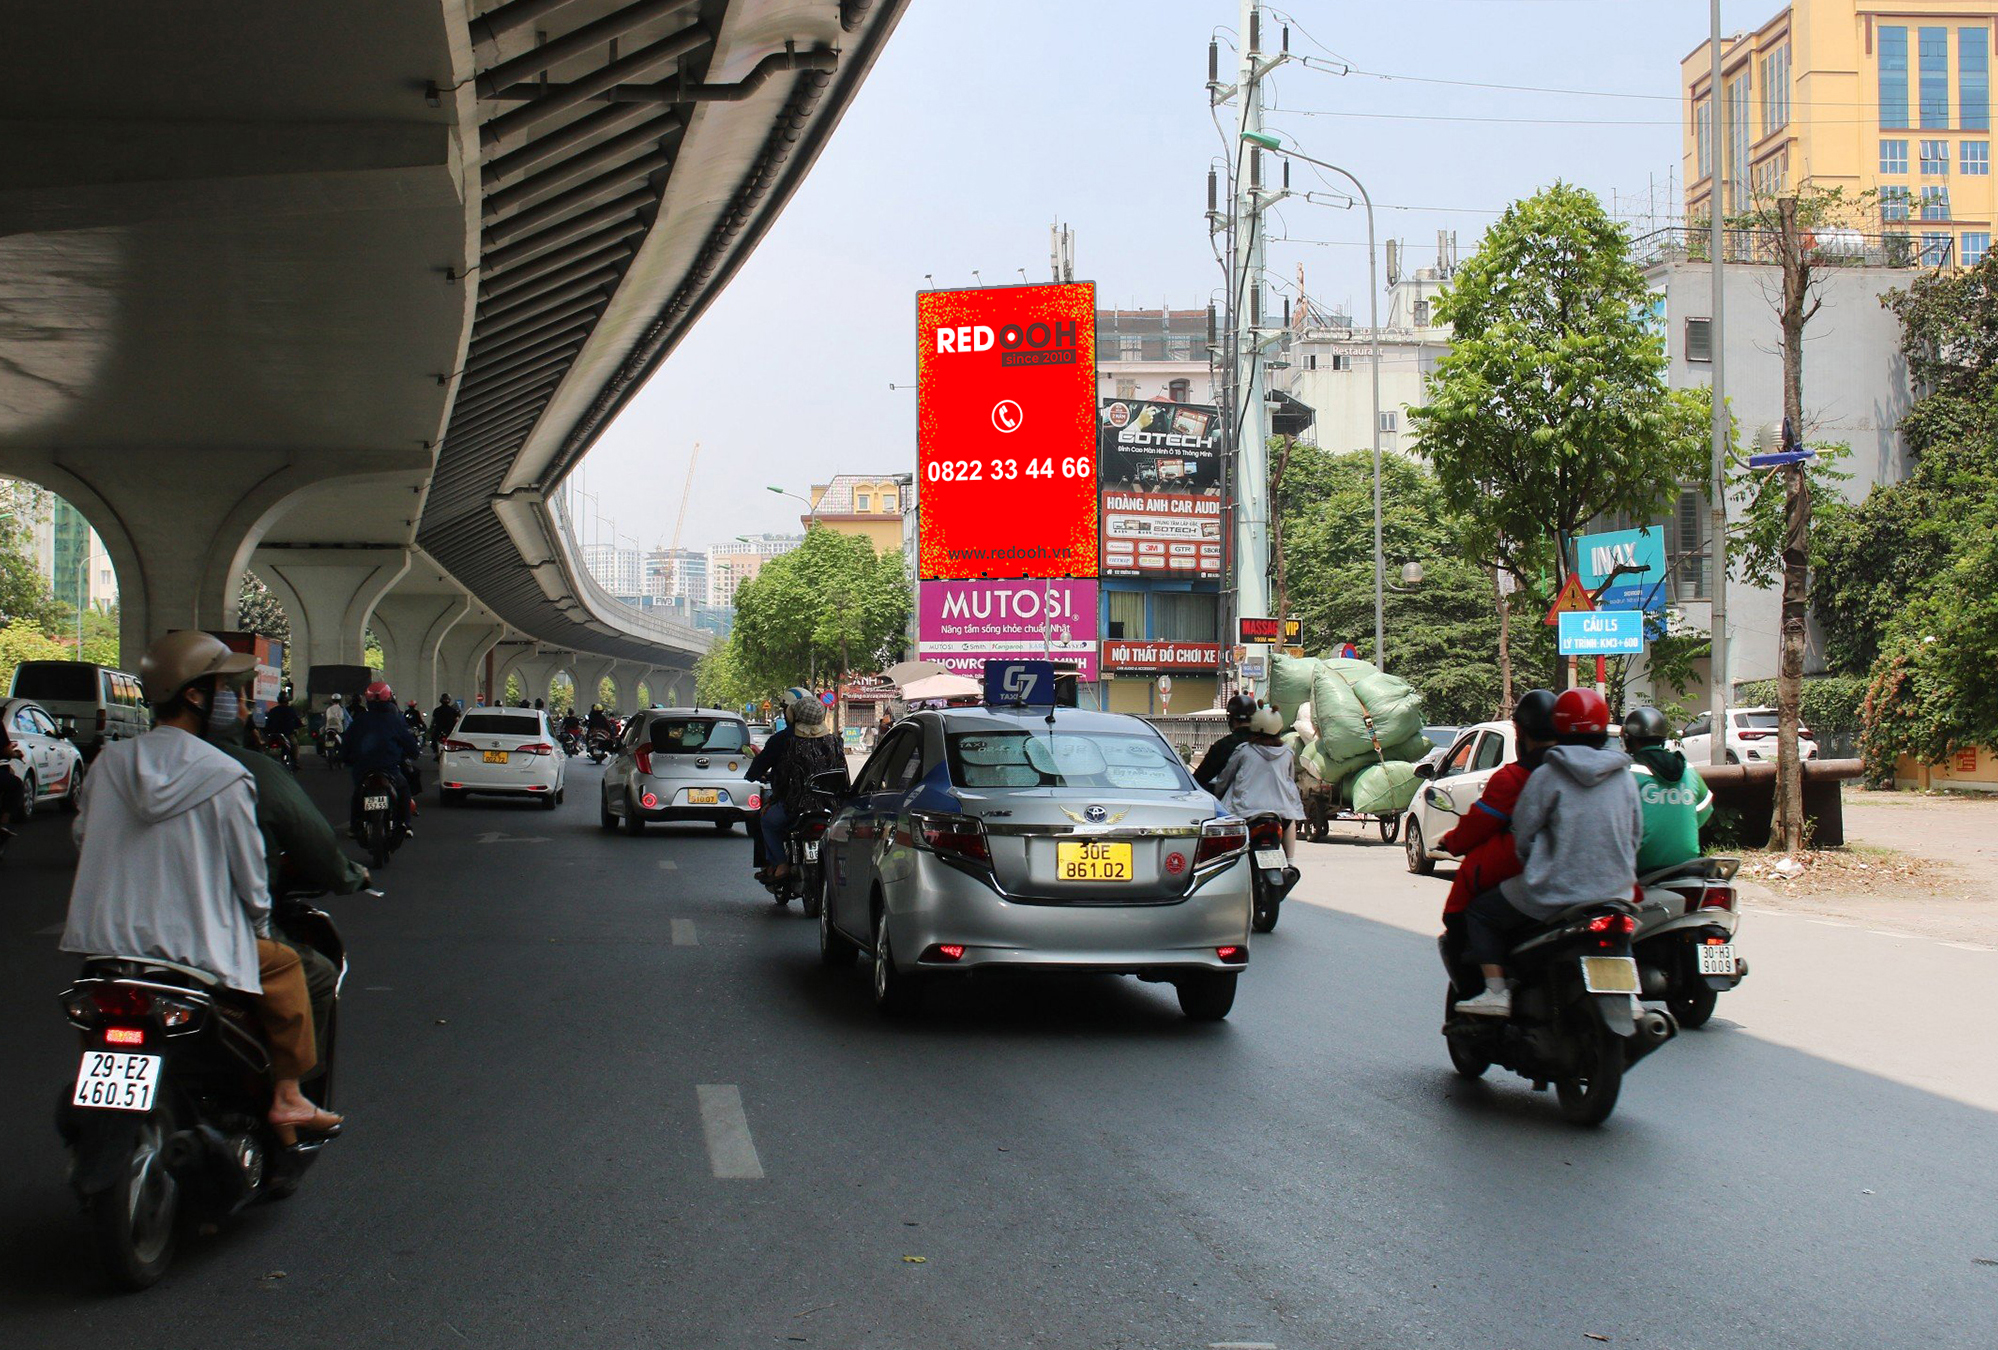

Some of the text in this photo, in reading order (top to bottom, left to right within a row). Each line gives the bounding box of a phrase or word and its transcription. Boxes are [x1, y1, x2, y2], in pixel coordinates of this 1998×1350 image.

[937, 321, 1076, 353] RED OOH
[1006, 352, 1071, 364] since 2010
[1144, 446, 1156, 454] Màn
[927, 456, 1090, 482] 0822 33 44 66
[1107, 494, 1220, 515] HOÀNG ANH CAR AUDI
[948, 545, 1071, 560] www.redooh.vn
[1591, 542, 1638, 576] INAX
[941, 589, 1070, 619] MUTOSI
[941, 625, 962, 635] Nâng
[981, 623, 1001, 635] sống
[1242, 620, 1299, 635] MASSAG VIP
[1583, 615, 1617, 632] CẦU L5
[1112, 645, 1130, 665] NỘI
[1132, 644, 1157, 662] THẤT
[1176, 648, 1201, 663] CHƠI
[1203, 650, 1216, 663] XE
[1003, 666, 1038, 699] G7
[1641, 783, 1695, 805] Grab
[1079, 844, 1111, 860] 30E
[1066, 862, 1124, 878] 861.02
[1703, 946, 1730, 959] 30-H3
[1704, 959, 1731, 973] 9009
[91, 1054, 149, 1080] 29-E2
[79, 1080, 149, 1108] 460.51
